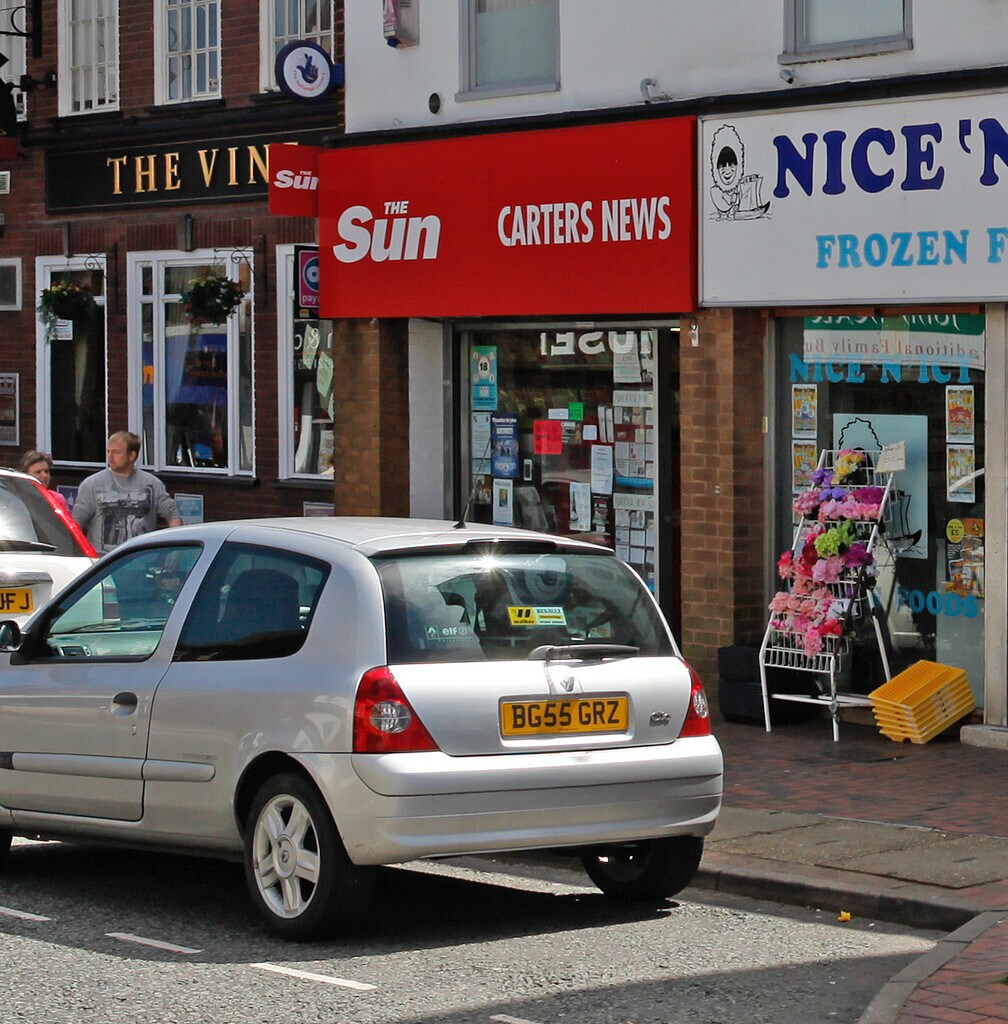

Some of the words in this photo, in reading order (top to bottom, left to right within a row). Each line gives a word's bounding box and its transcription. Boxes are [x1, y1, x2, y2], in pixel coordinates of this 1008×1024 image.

[106, 150, 181, 195] THE
[197, 142, 298, 187] VIN
[772, 122, 945, 199] NICE
[383, 200, 409, 215] THE
[498, 201, 595, 247] CARTERS
[601, 196, 672, 242] NEWS
[333, 205, 441, 263] Sun
[815, 229, 970, 269] FROZEN
[302, 295, 319, 304] pay
[479, 362, 488, 371] 18
[788, 353, 866, 383] NICE
[917, 353, 976, 383] ICY
[512, 703, 573, 729] BG55
[578, 701, 620, 725] GRZ
